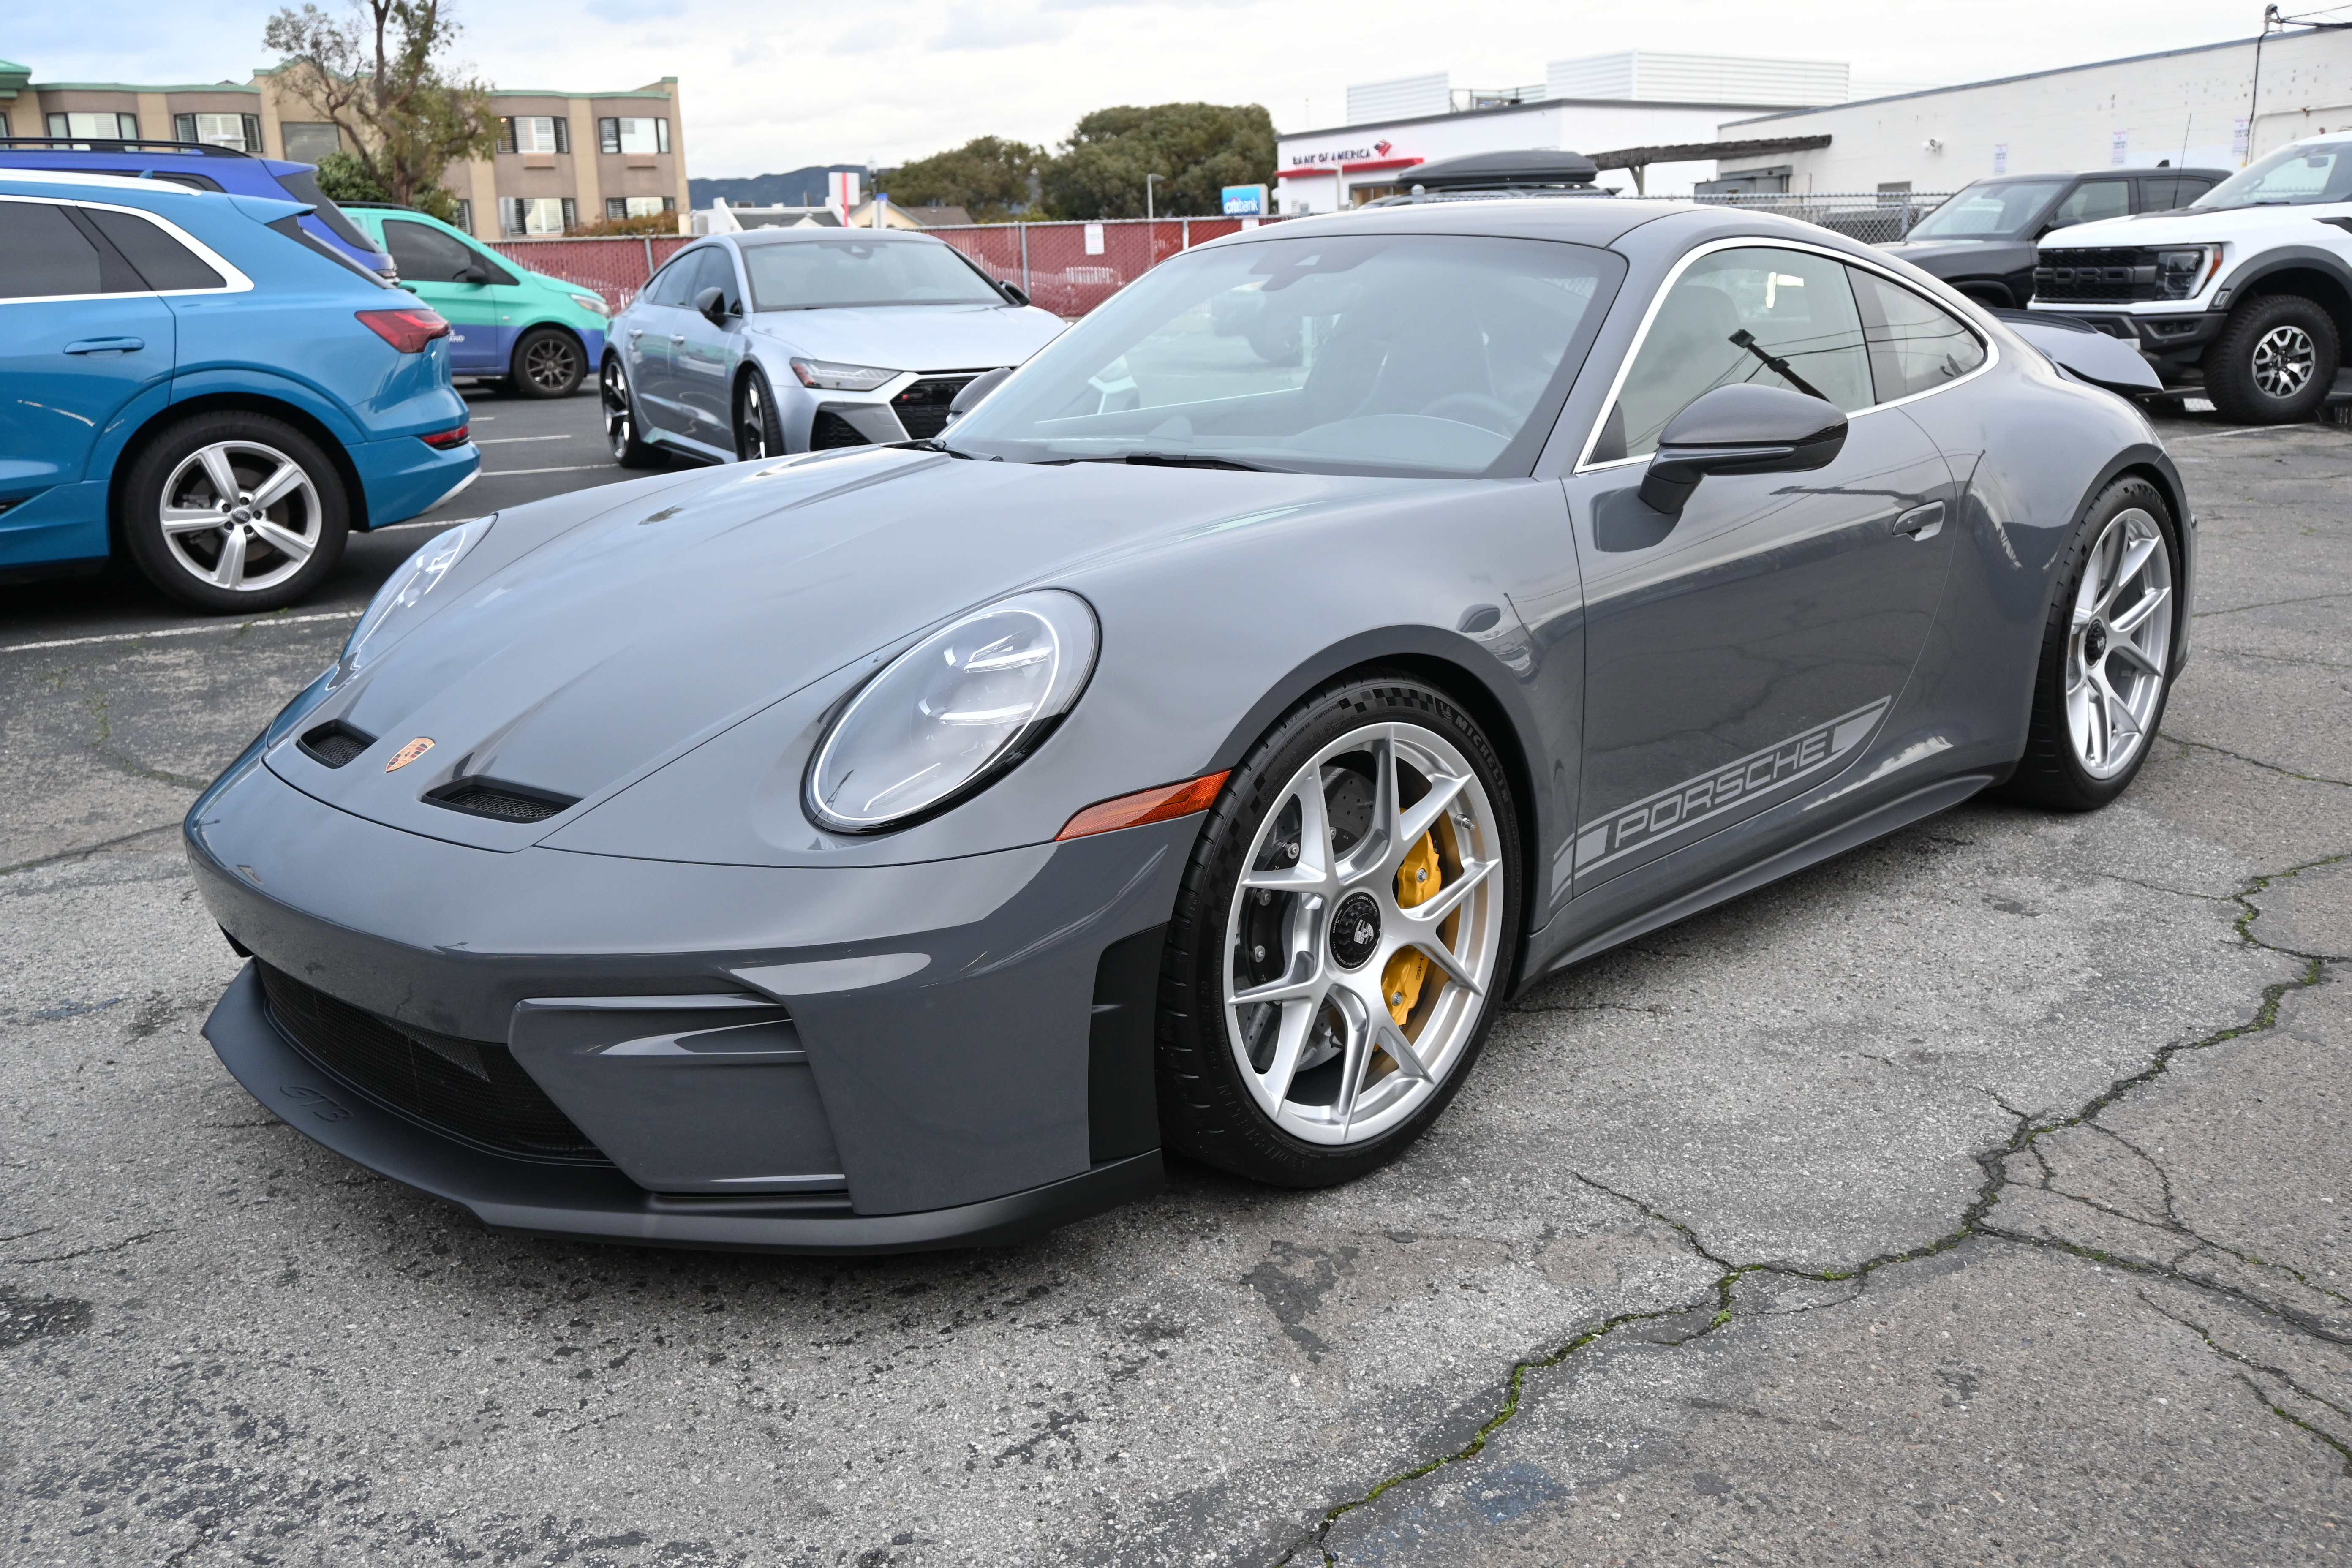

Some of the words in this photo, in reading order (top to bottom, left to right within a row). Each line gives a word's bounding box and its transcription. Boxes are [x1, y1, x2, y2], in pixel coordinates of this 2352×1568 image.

[1293, 154, 1315, 165] BANK
[1318, 152, 1328, 162] OF
[1331, 148, 1371, 161] AMERICA
[1224, 197, 1258, 214] citibank
[2033, 267, 2134, 284] FORD
[1287, 727, 1306, 746] TRACTION
[1314, 703, 1340, 721] TEMPERATURE
[1455, 715, 1510, 803] MICHELIN
[1614, 731, 1828, 848] PORSCHE
[280, 1085, 354, 1122] GT3
